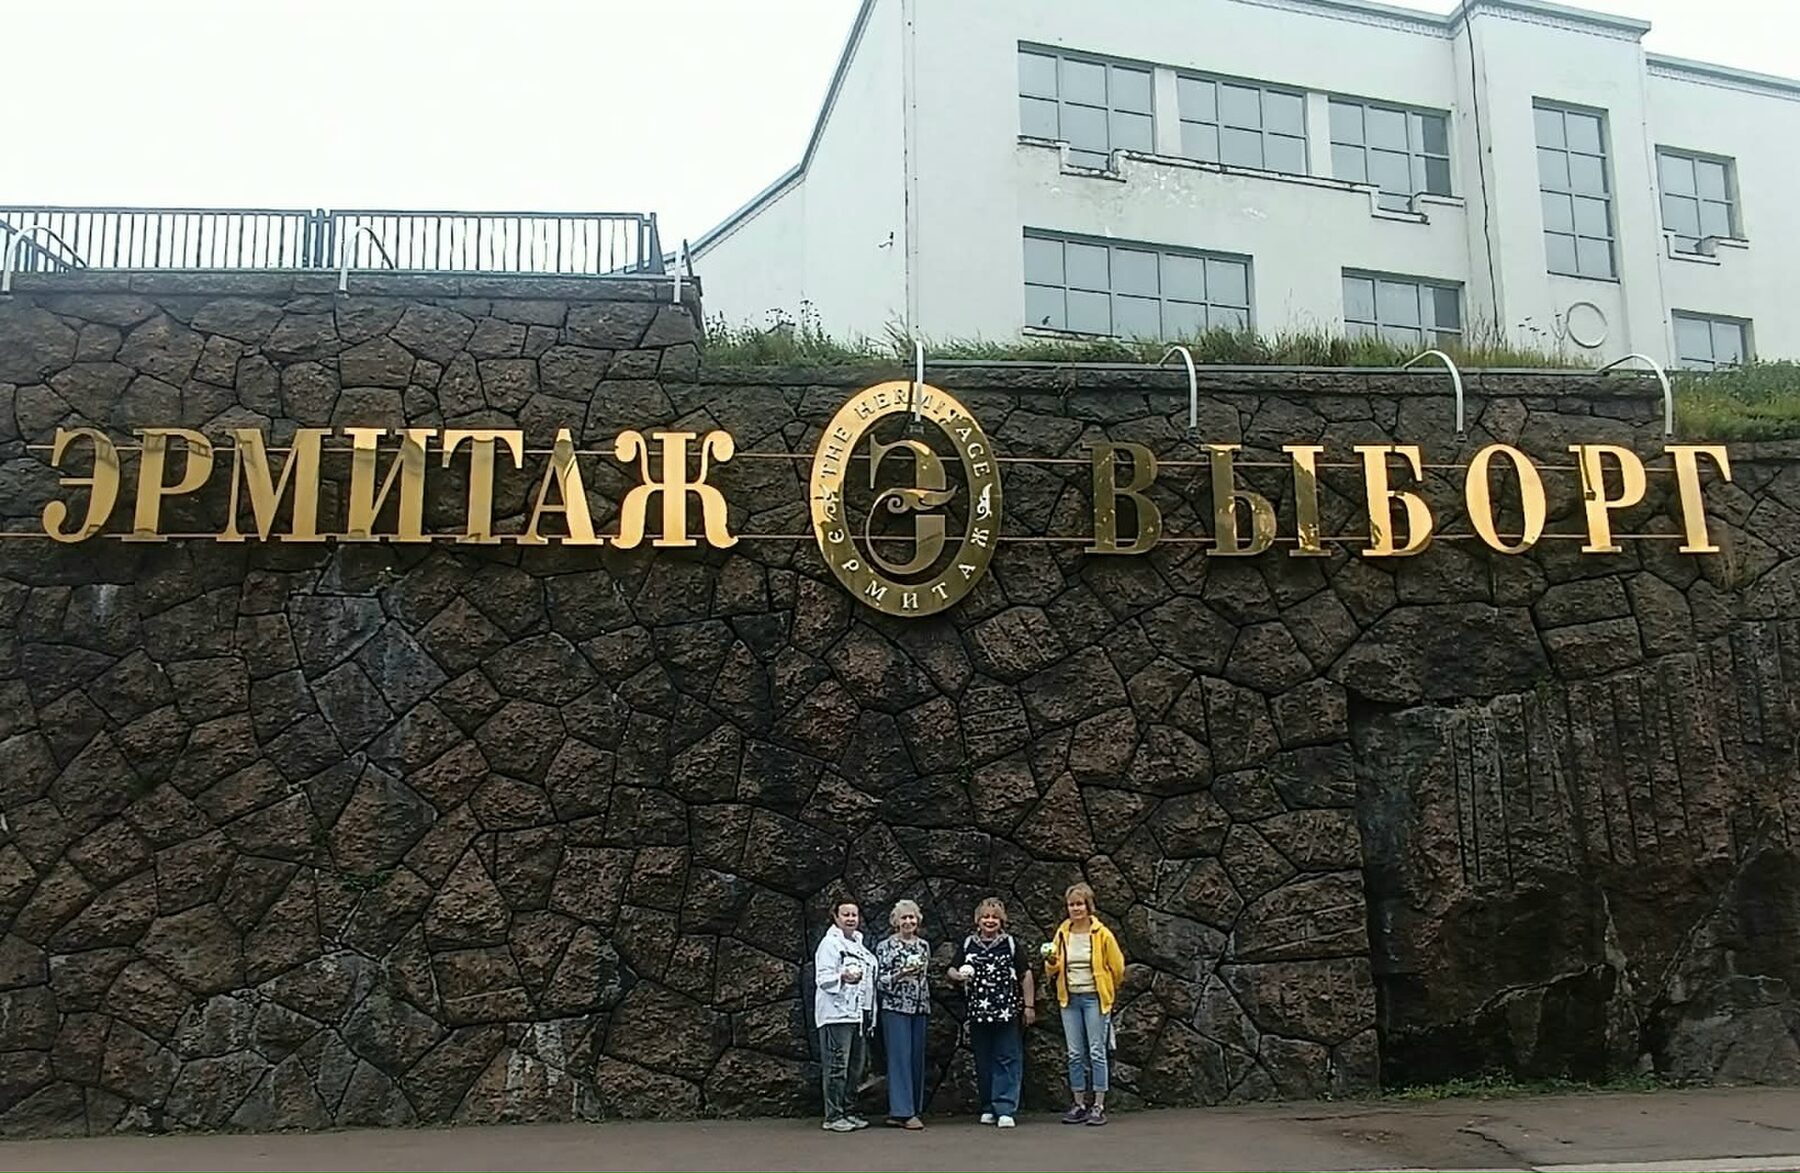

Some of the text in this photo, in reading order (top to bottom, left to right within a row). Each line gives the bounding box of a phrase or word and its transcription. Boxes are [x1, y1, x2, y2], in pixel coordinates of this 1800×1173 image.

[42, 427, 738, 549] ЭРМИТАЖ
[821, 427, 852, 479] THE
[1082, 441, 1732, 558] ВЫБОРГ
[828, 527, 990, 610] ЭРМИТАЖ
